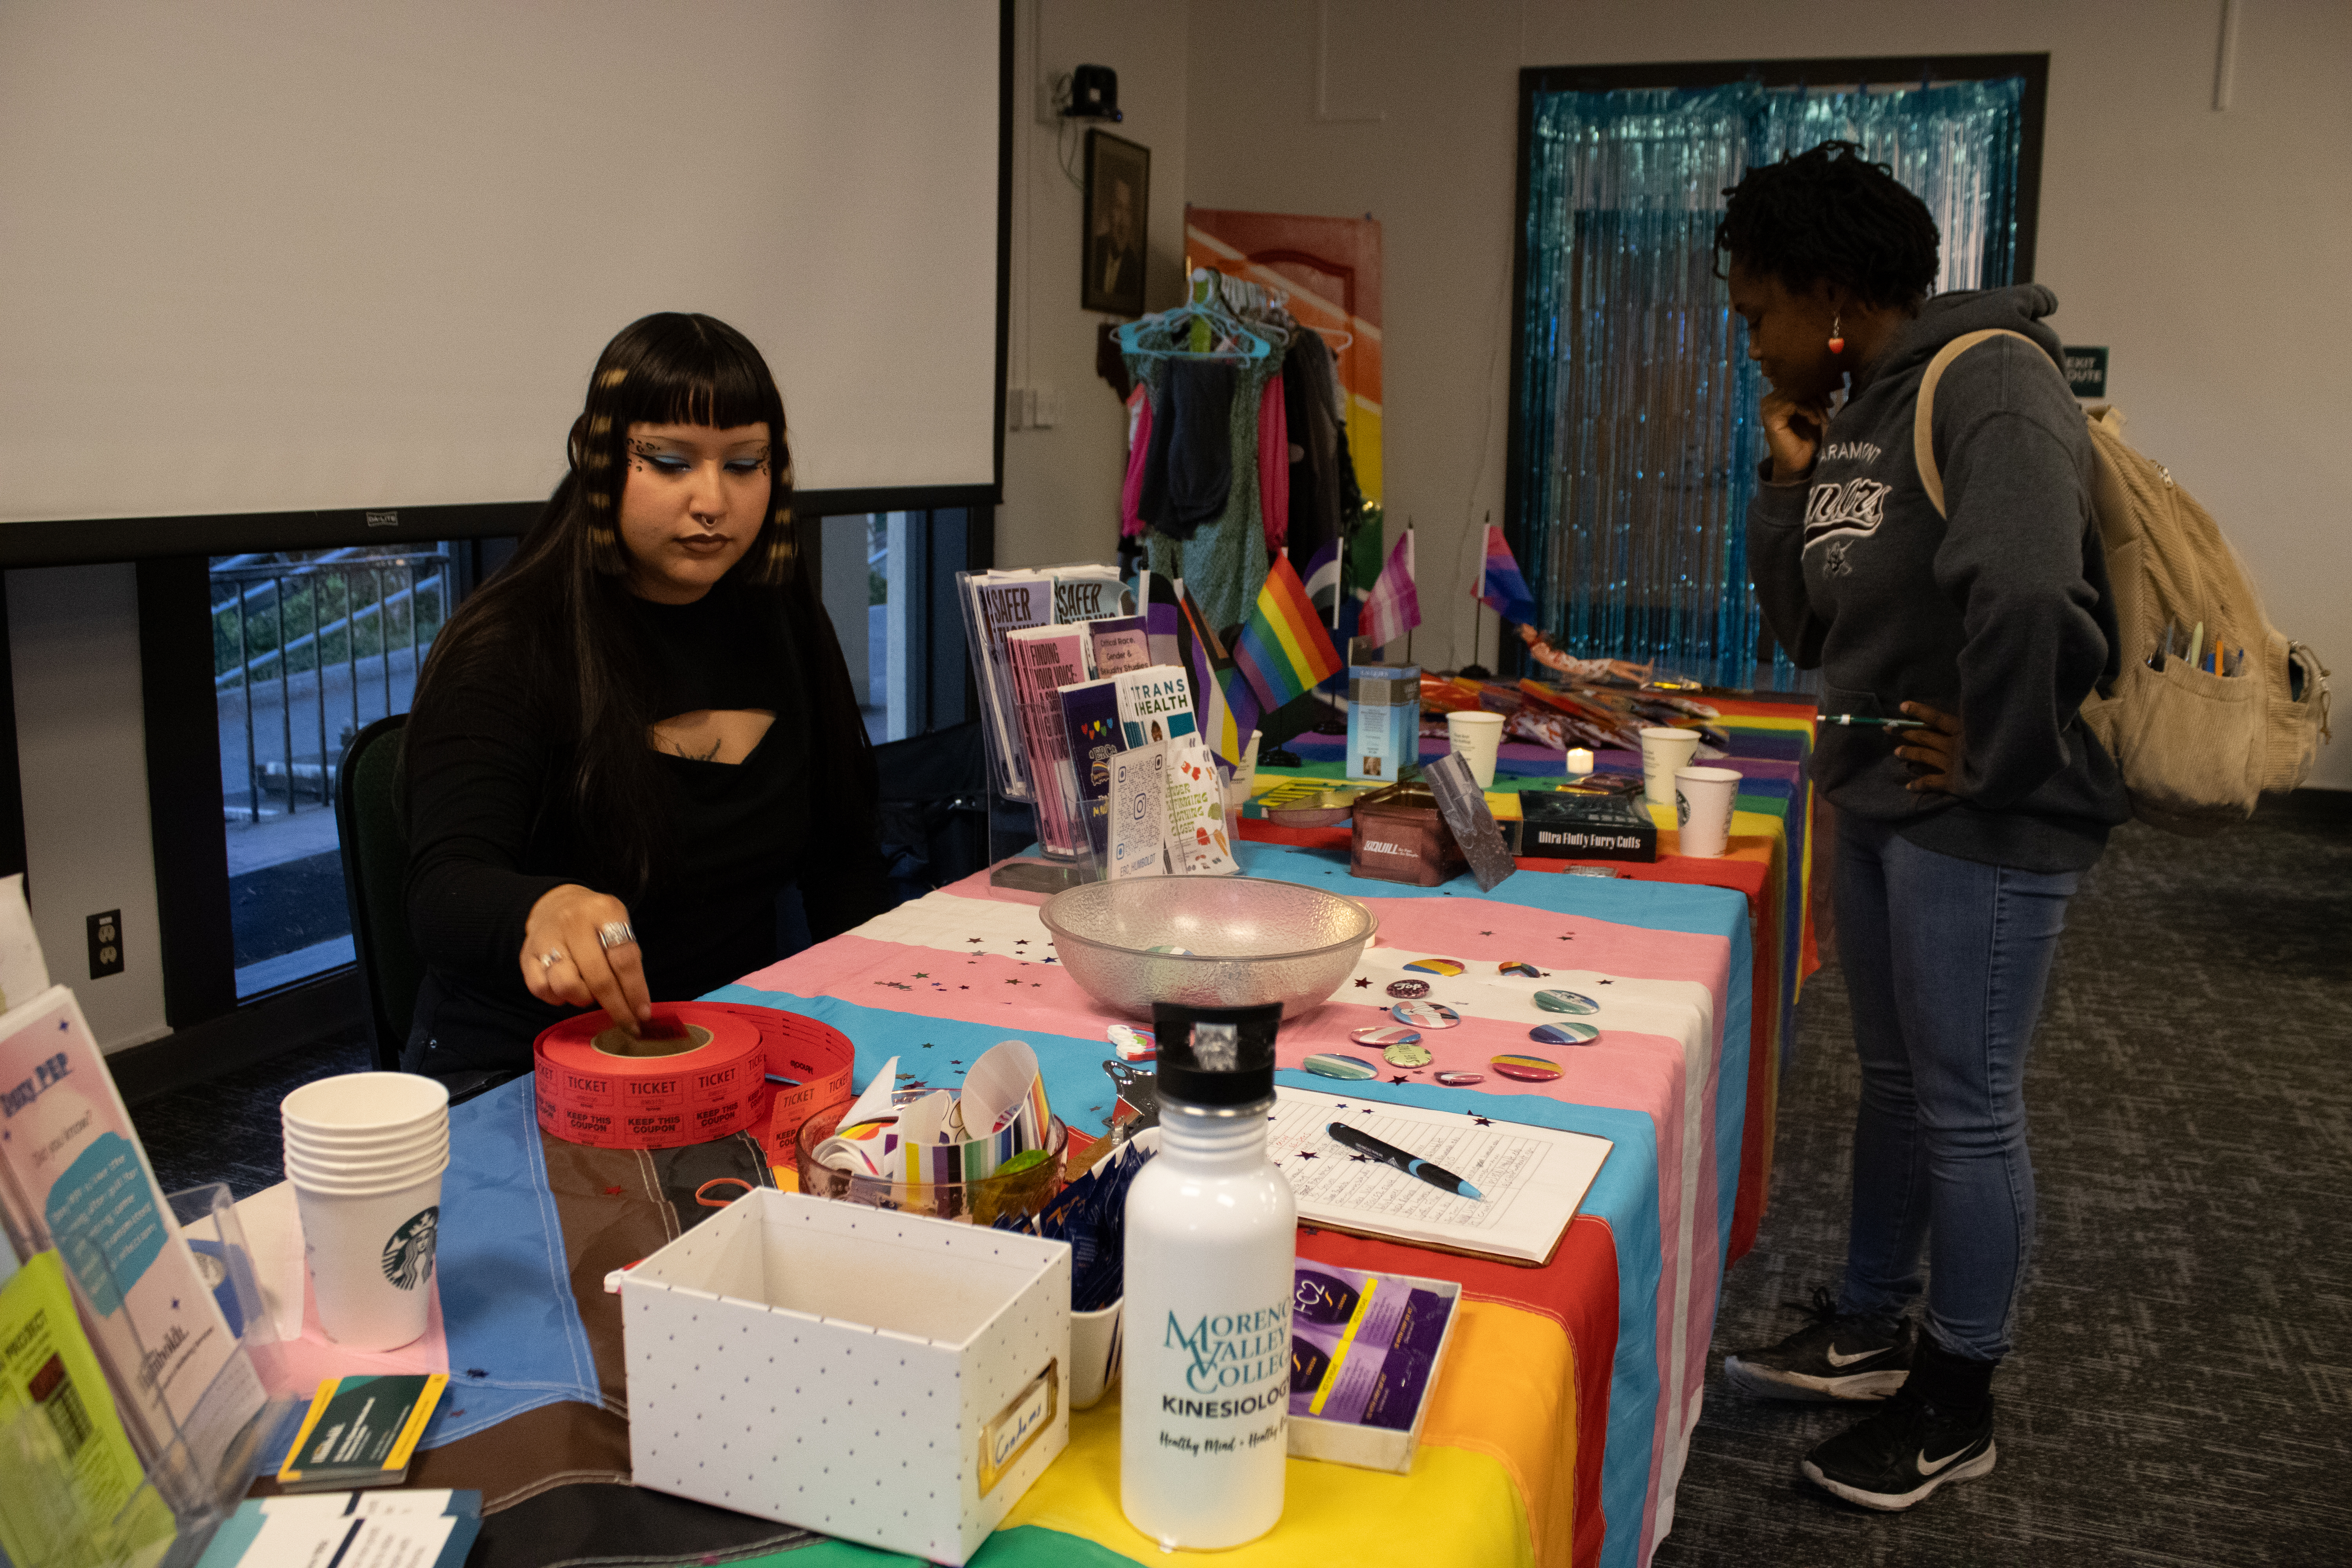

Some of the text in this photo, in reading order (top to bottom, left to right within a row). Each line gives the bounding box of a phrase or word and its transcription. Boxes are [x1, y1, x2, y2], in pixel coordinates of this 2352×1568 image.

[2065, 356, 2096, 368] EXIT
[2067, 369, 2102, 383] OUTE
[991, 587, 1032, 623] SAFER
[1059, 583, 1102, 617] SAFER
[1100, 638, 1116, 646] Critical
[1030, 642, 1060, 666] FINDING
[1107, 651, 1125, 660] Gender
[1124, 662, 1149, 673] Studies
[1135, 679, 1185, 699] TRANS
[1139, 694, 1188, 715] HEALTH
[1166, 783, 1191, 798] ENDER
[1539, 831, 1641, 849] Ultra Fluffy Furry Cuffs
[1396, 1044, 1420, 1063] SHE/THE
[568, 1076, 607, 1093] TICKET
[698, 1068, 736, 1088] TICKET
[829, 1072, 849, 1093] TICKET
[630, 1081, 676, 1094] TICKET
[784, 1088, 815, 1108] TICKET
[567, 1111, 611, 1125] KEEP THIS
[696, 1102, 739, 1120] KEEP THIS
[701, 1112, 735, 1126] COUPON
[571, 1119, 607, 1132] COUPON
[657, 1116, 680, 1124] THIS
[633, 1124, 676, 1133] COUPON
[776, 1129, 796, 1141] KEEP
[779, 1137, 795, 1148] COU
[1186, 1348, 1289, 1394] COLLEG
[1160, 1425, 1278, 1457] Healthy Mind Healthy
